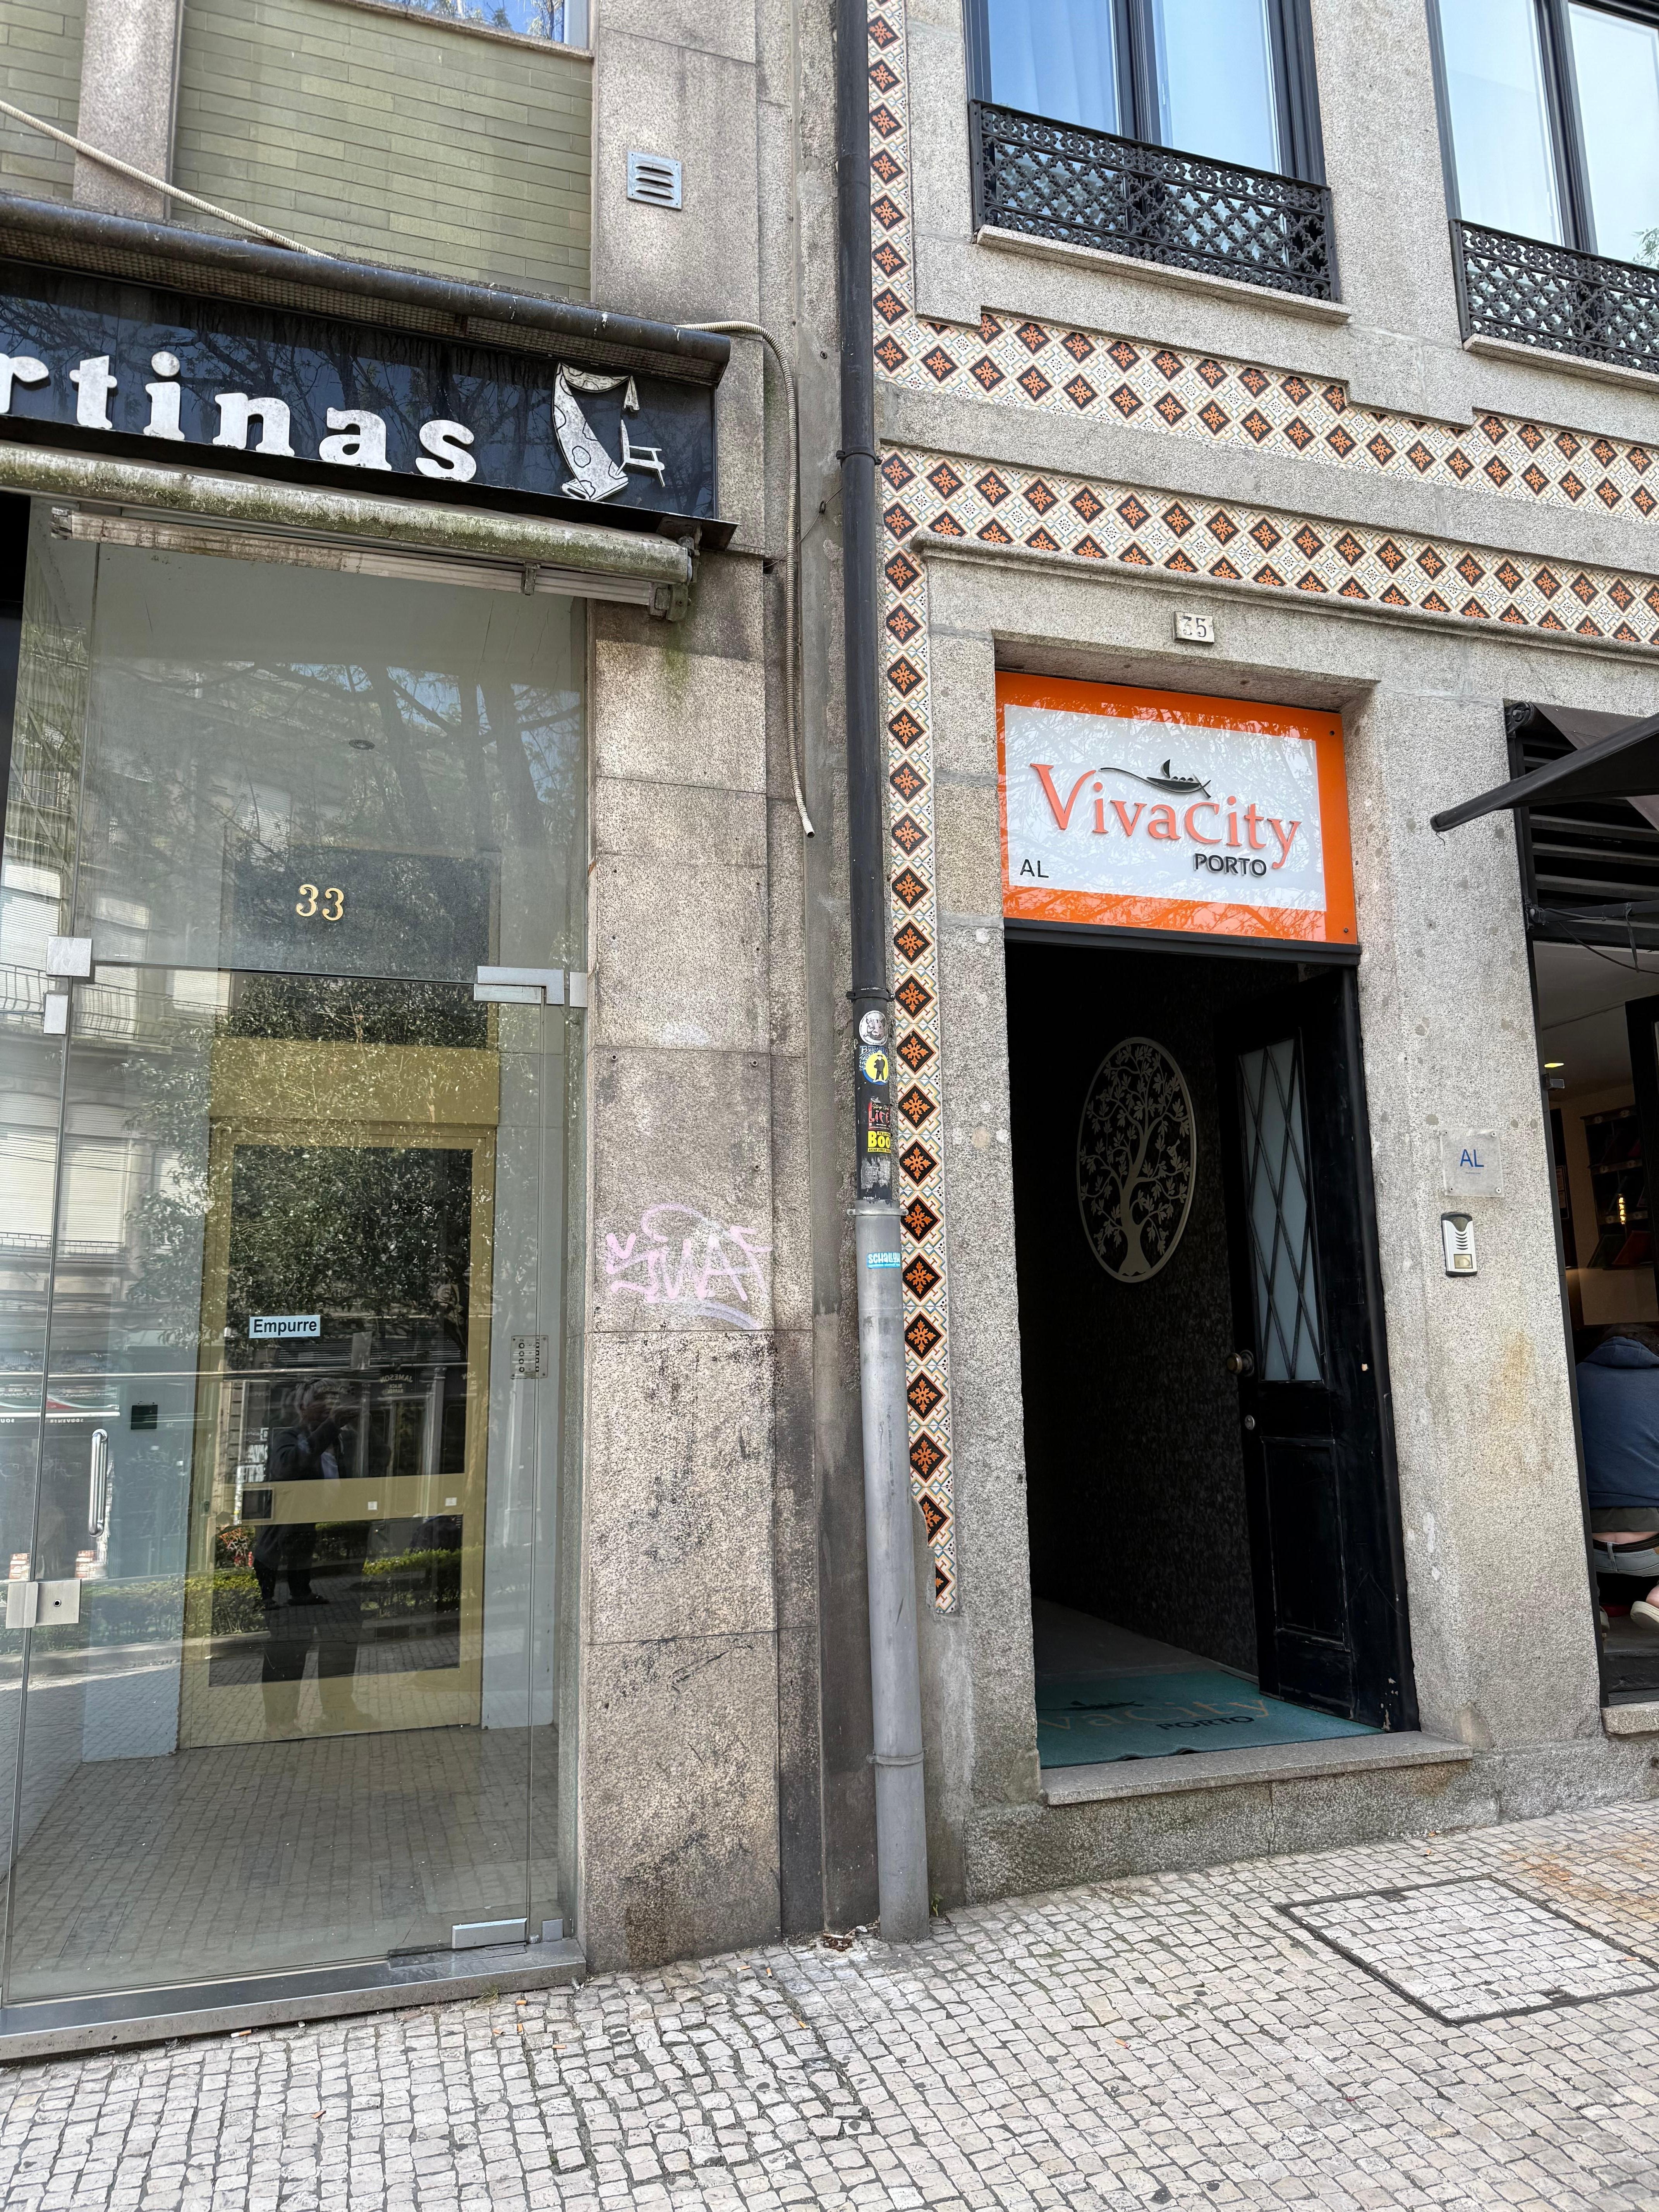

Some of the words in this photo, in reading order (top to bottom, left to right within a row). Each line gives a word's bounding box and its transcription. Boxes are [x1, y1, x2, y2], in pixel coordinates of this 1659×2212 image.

[0, 351, 476, 481] rtinas
[1182, 616, 1206, 637] 35
[1030, 763, 1302, 869] VivaCity
[1020, 859, 1049, 878] AL
[1194, 853, 1267, 876] PORTO
[296, 884, 345, 921] 33
[1460, 1149, 1484, 1167] AL
[254, 1319, 317, 1336] Empurre
[1156, 1716, 1255, 1730] PORTO
